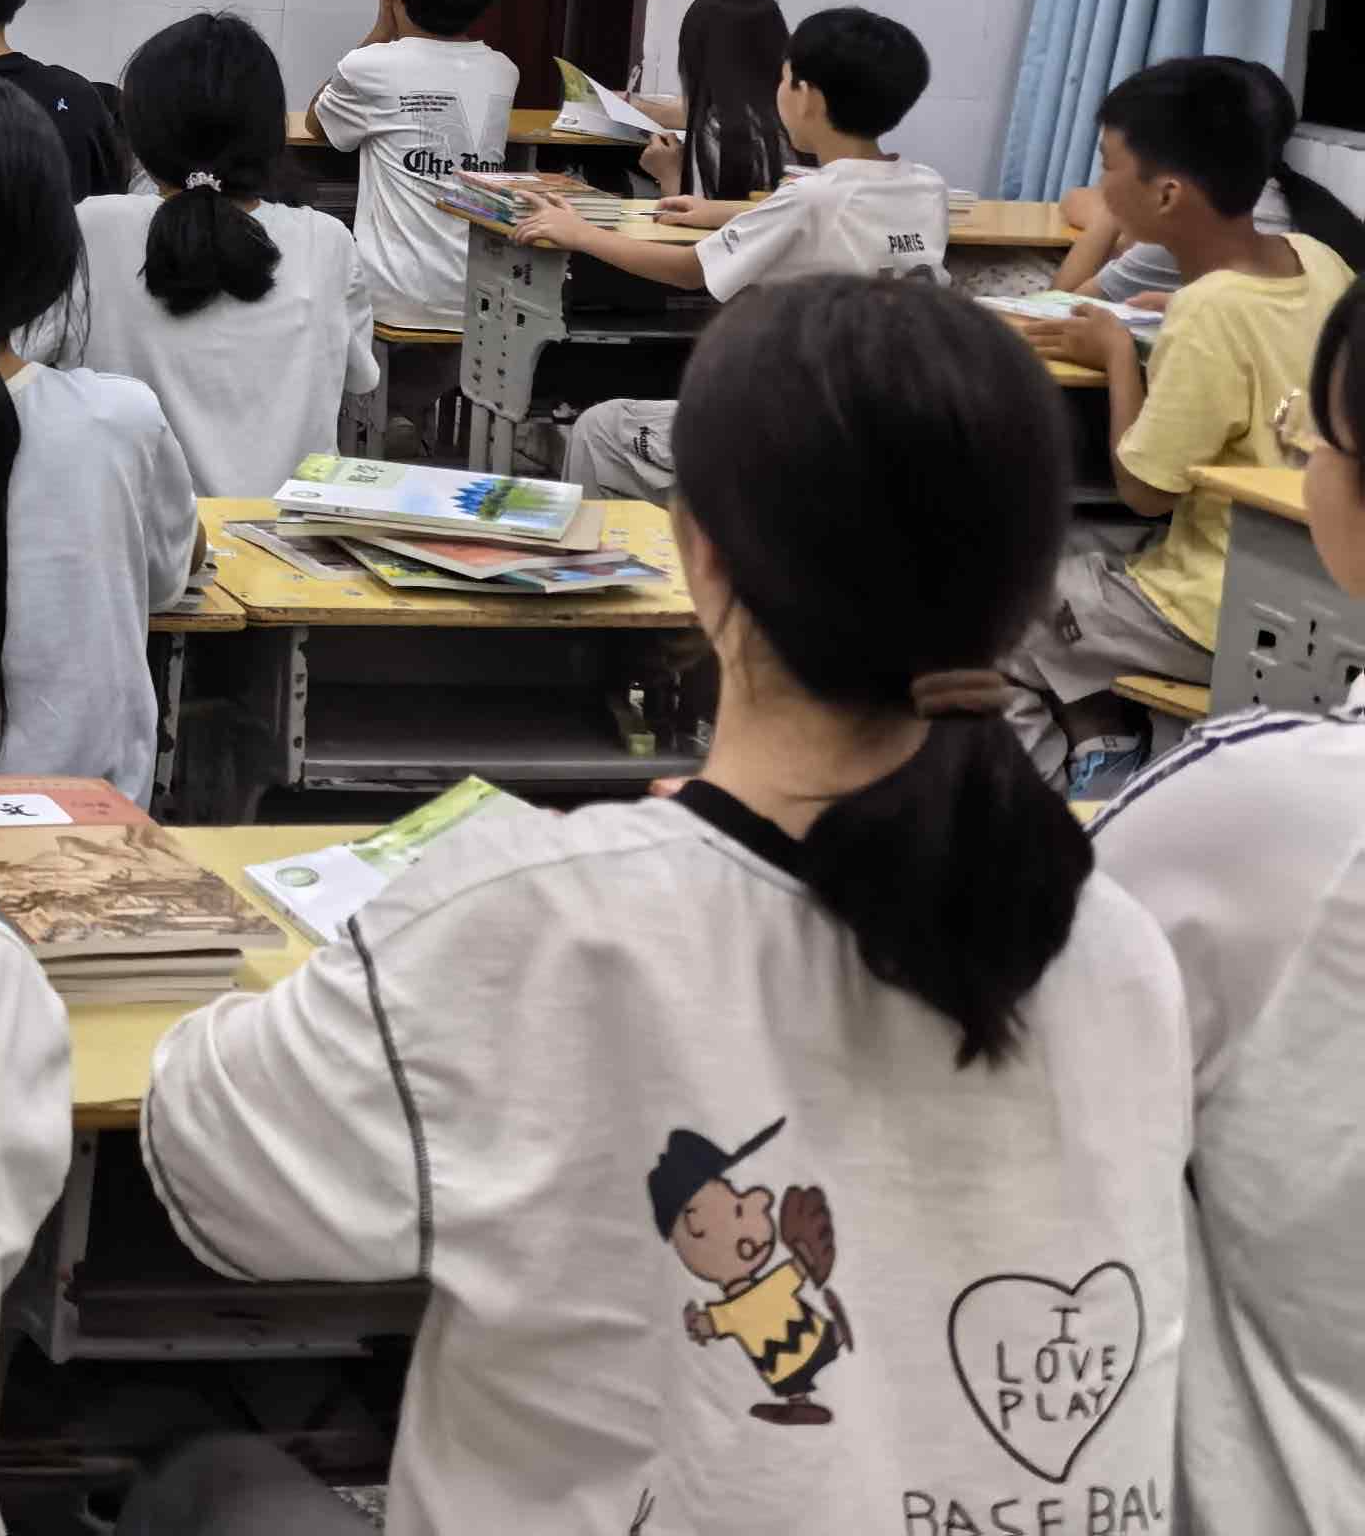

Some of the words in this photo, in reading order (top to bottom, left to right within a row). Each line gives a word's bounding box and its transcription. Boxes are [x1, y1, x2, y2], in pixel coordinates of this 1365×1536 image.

[888, 233, 925, 254] PARIS
[1052, 1306, 1081, 1345] I
[996, 1340, 1117, 1384] LOVE
[998, 1387, 1111, 1430] PLAY
